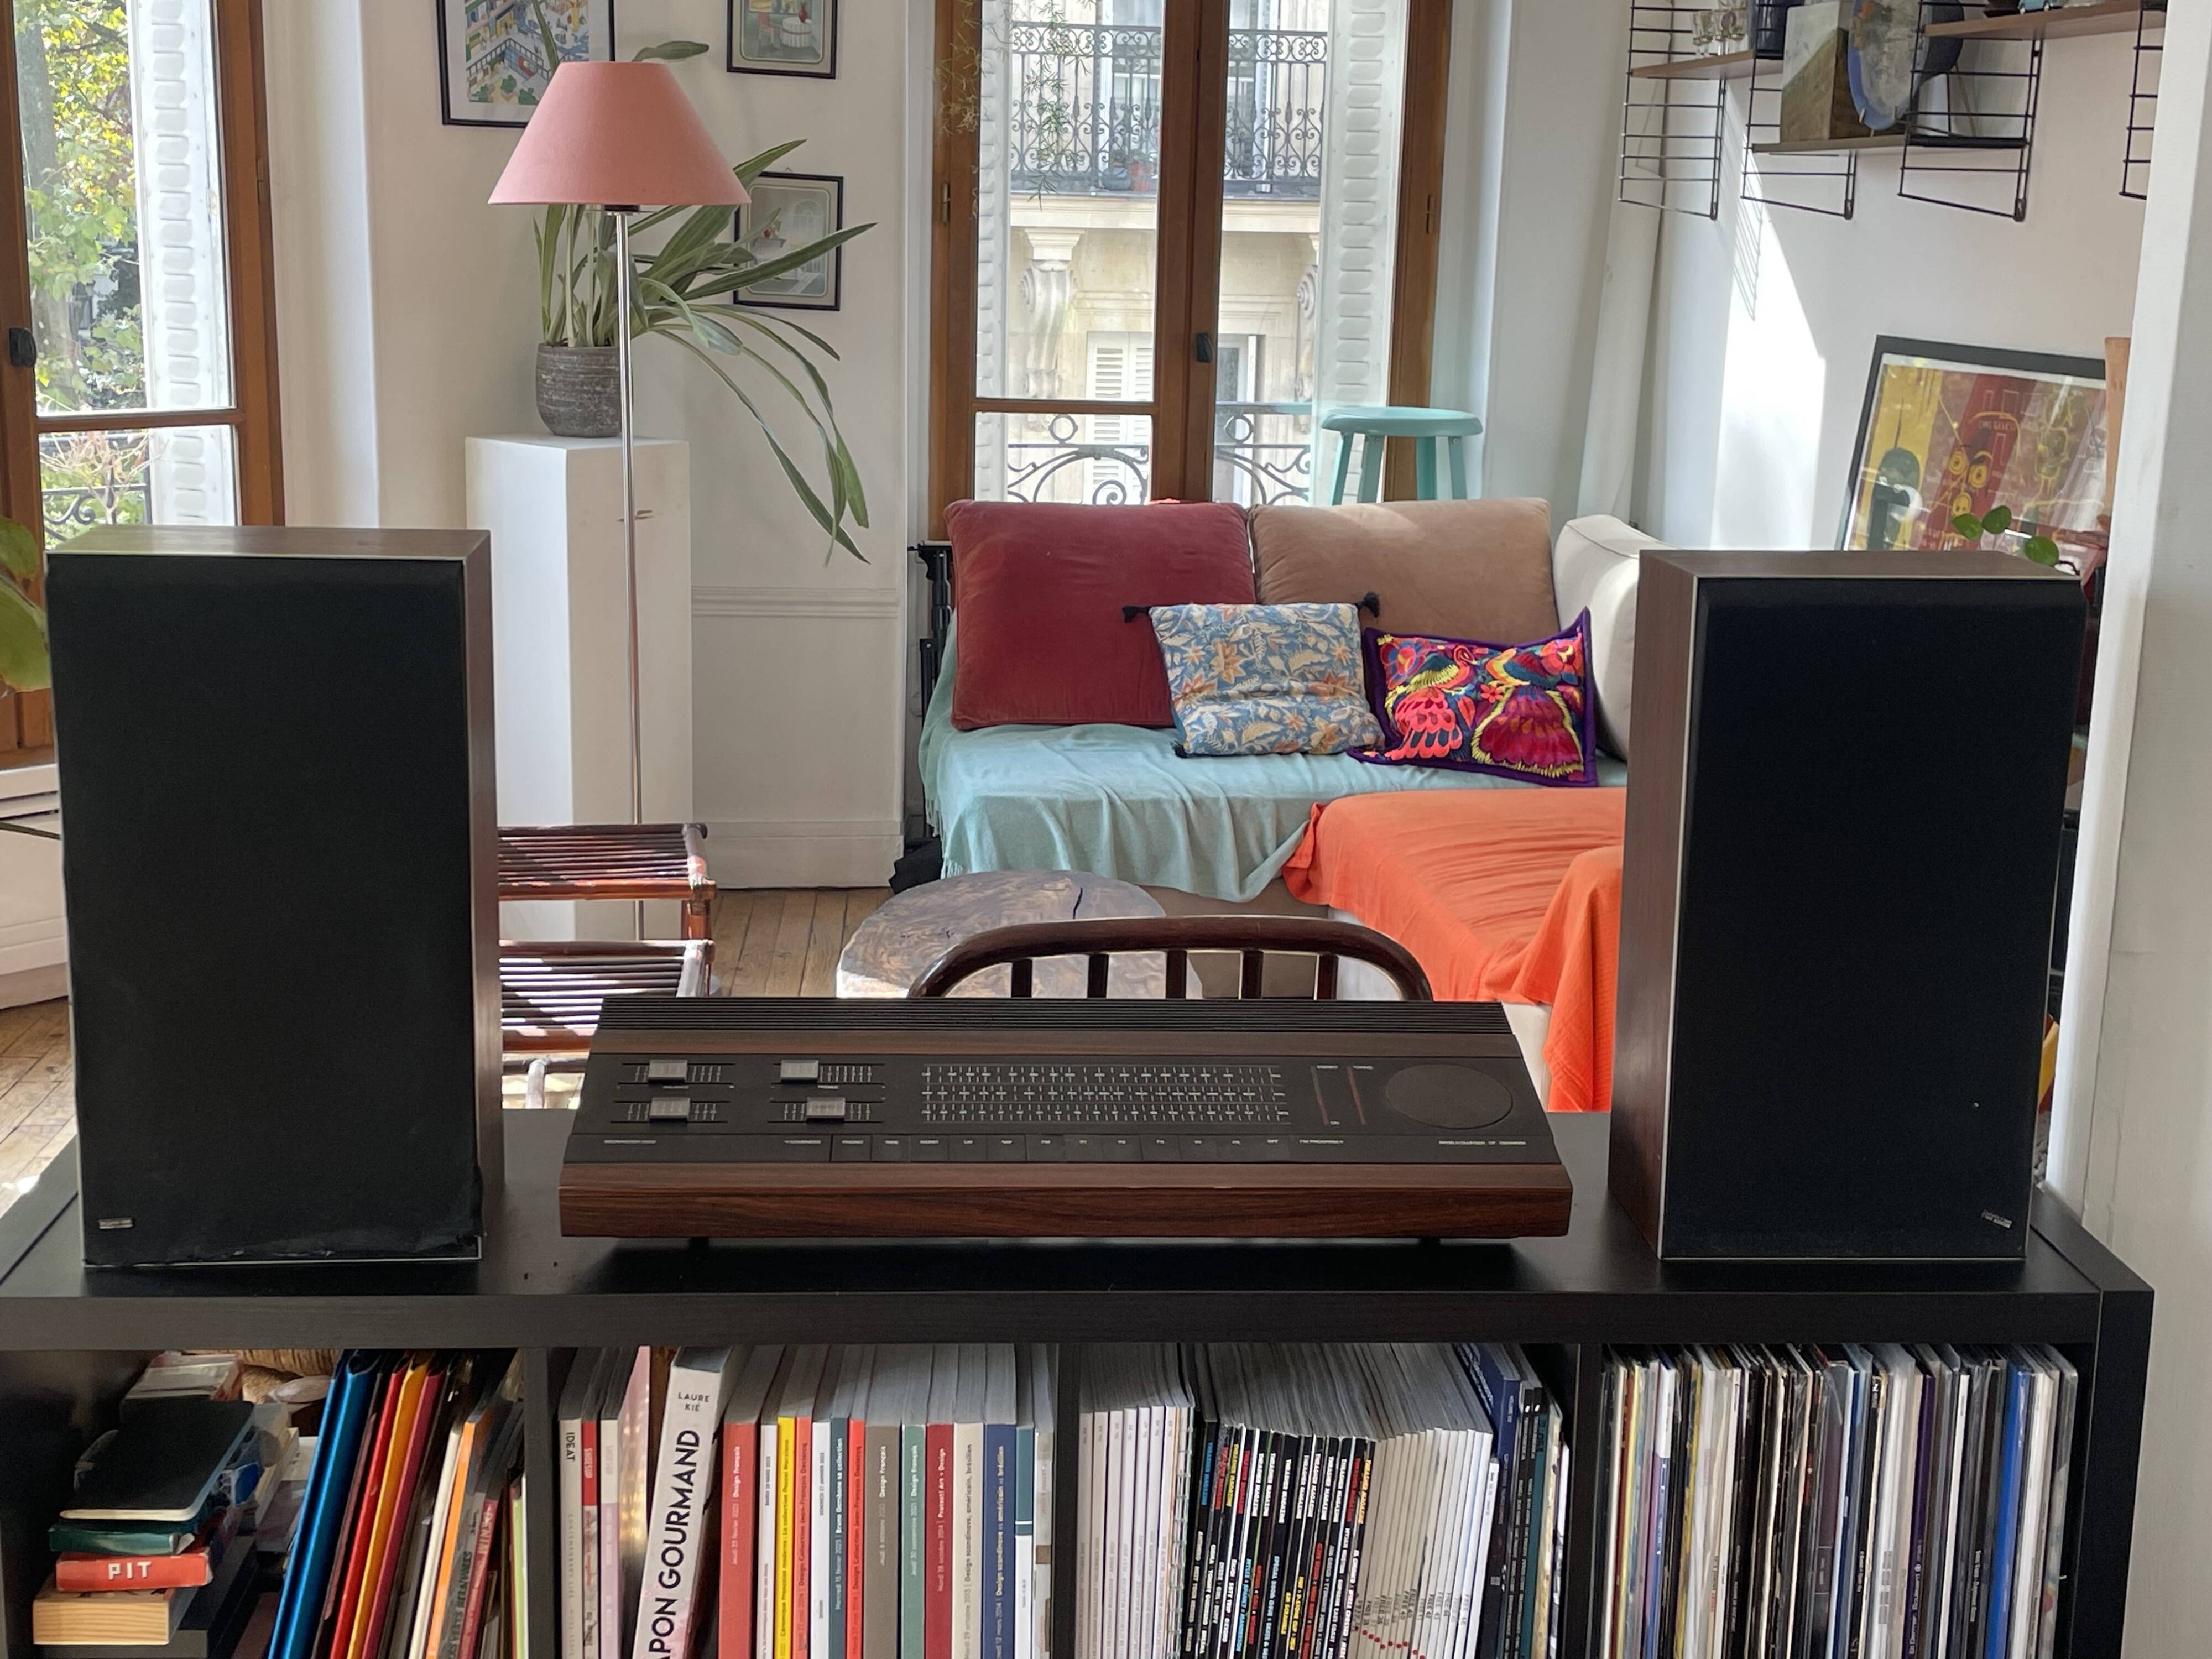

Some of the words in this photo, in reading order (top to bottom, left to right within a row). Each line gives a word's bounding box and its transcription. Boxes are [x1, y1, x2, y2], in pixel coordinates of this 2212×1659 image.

[677, 1391, 710, 1403] LAURE
[565, 1432, 576, 1462] IDEAT
[733, 1446, 742, 1474] français
[1282, 1459, 1292, 1490] THRASHER
[1300, 1455, 1310, 1485] THRASHER
[1312, 1453, 1321, 1484] THRASHER
[1325, 1456, 1334, 1487] THRASHER
[1338, 1459, 1347, 1489] THRASHER
[733, 1475, 742, 1498] Design
[1307, 1485, 1317, 1517] MAGAZINE
[658, 1430, 701, 1589] GOURMAND
[1278, 1491, 1288, 1524] MAGAZINE
[1296, 1486, 1305, 1519] MAGAZINE
[1321, 1488, 1330, 1520] MAGAZINE
[1333, 1490, 1343, 1522] MAGAZINE
[782, 1527, 789, 1536] La
[108, 1561, 152, 1580] PIT
[799, 1562, 807, 1586] Design
